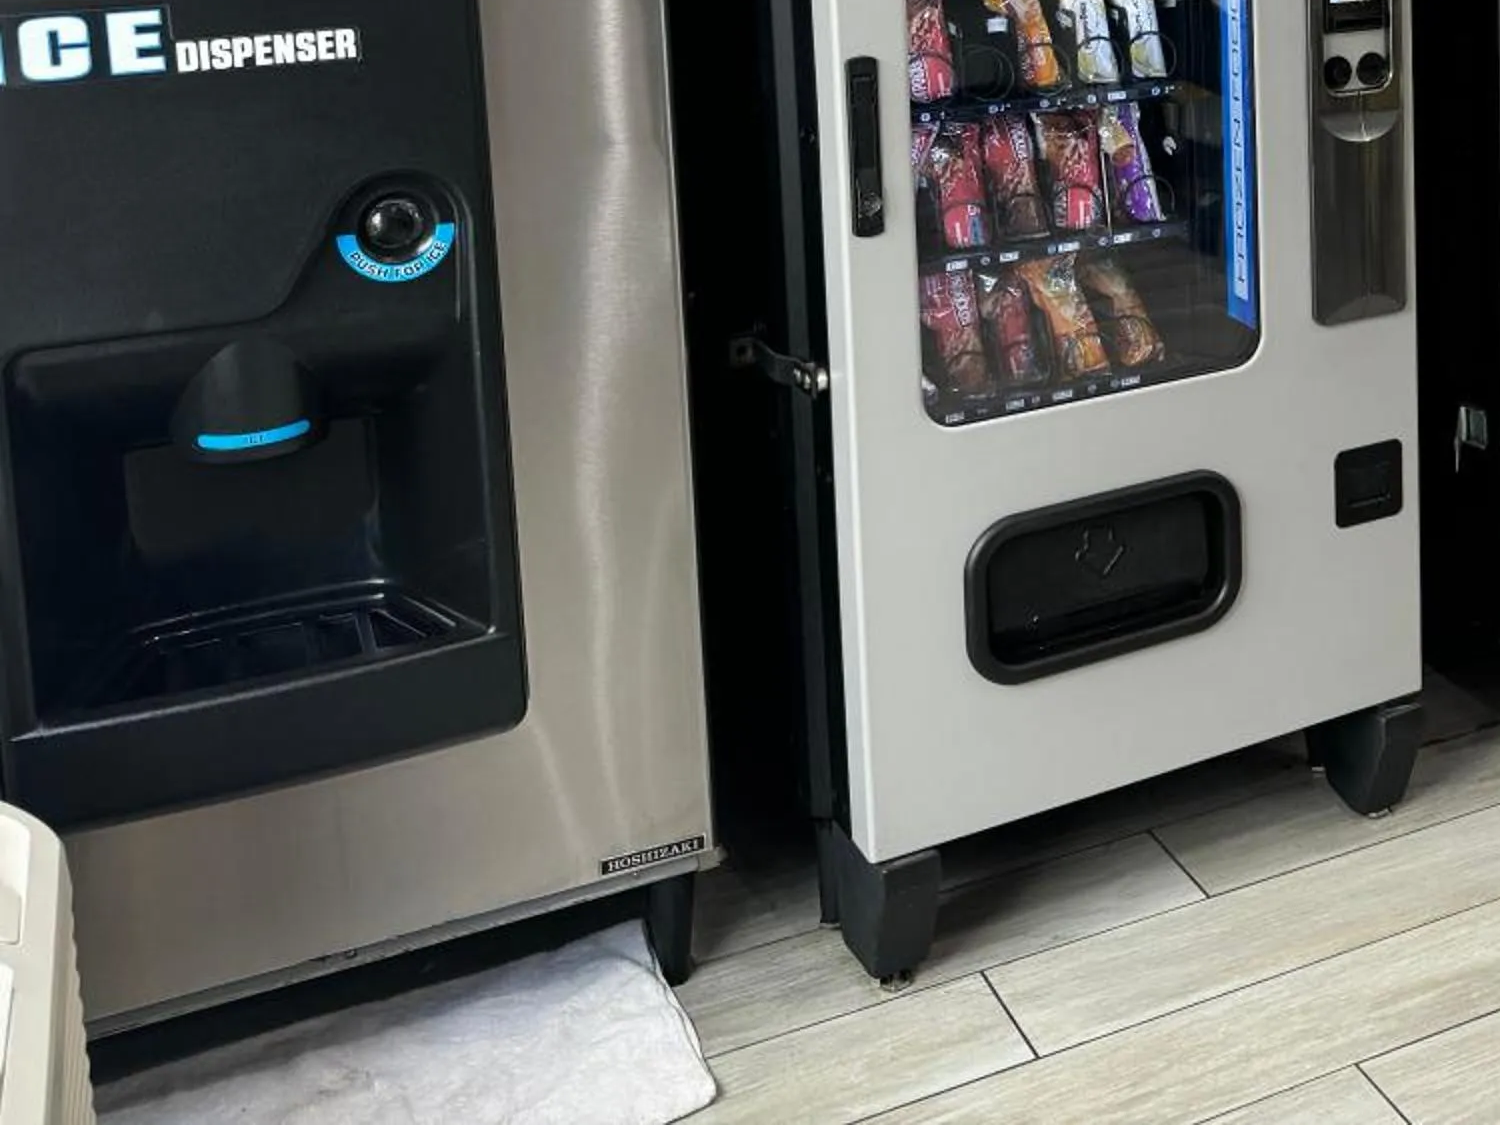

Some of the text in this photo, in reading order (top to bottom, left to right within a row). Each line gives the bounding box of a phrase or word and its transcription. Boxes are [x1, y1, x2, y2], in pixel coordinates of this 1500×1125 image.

[0, 8, 358, 85] CE DISPENSER
[1231, 119, 1246, 284] FROZEN
[350, 252, 389, 277] PUSH
[428, 242, 447, 263] ICE
[607, 838, 699, 872] HOSHIZAKI
